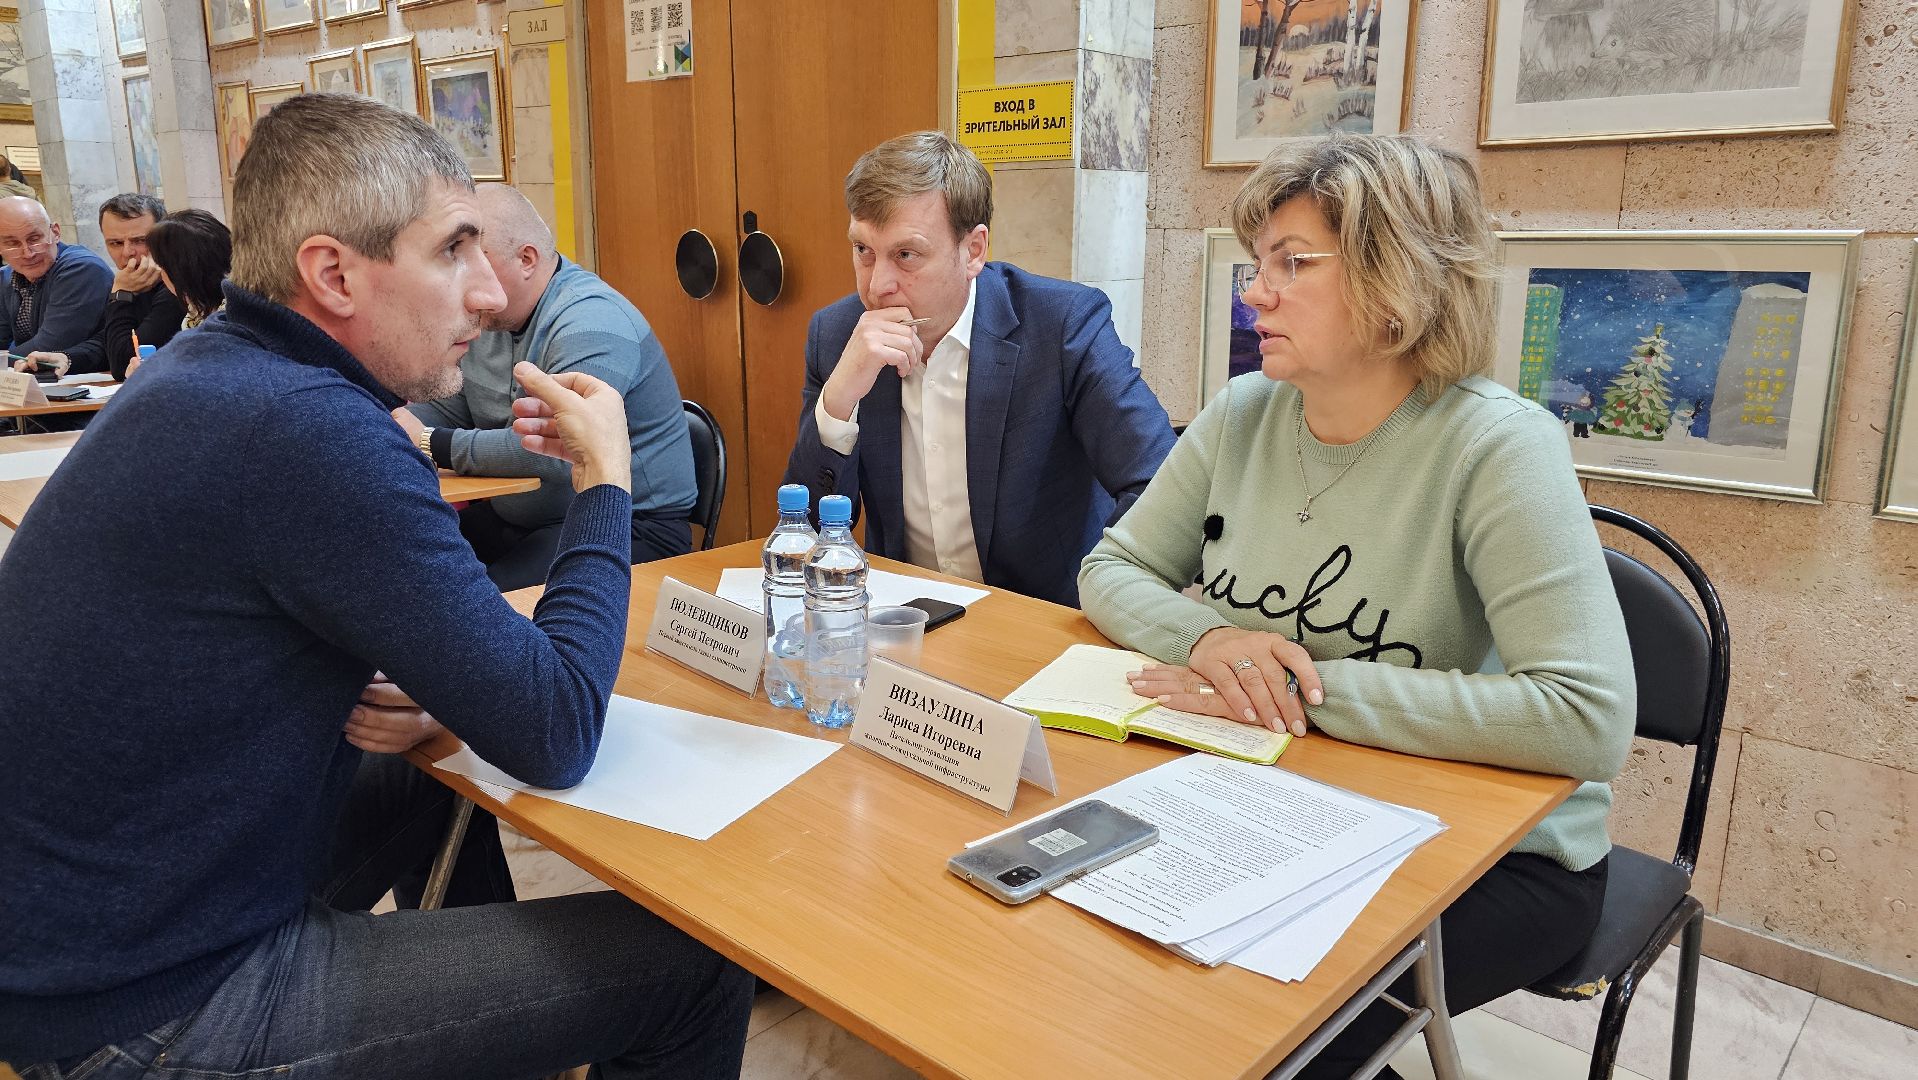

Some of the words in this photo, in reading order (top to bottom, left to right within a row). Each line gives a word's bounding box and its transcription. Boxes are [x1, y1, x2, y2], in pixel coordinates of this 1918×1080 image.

[527, 19, 548, 33] ЗАЛ
[964, 115, 1040, 133] ЗРИТЕЛЬНЫЙ
[1042, 116, 1066, 130] ЗАЛ
[994, 99, 1025, 114] ВХОД
[1028, 98, 1036, 111] В
[670, 597, 749, 640] ПОЛЕВЩИКОВ
[670, 619, 698, 640] Сергей
[698, 630, 741, 658] Петрович
[889, 682, 984, 736] ВИЗАУЛИНА
[878, 705, 920, 734] Лариса
[921, 722, 982, 761] Игоревна
